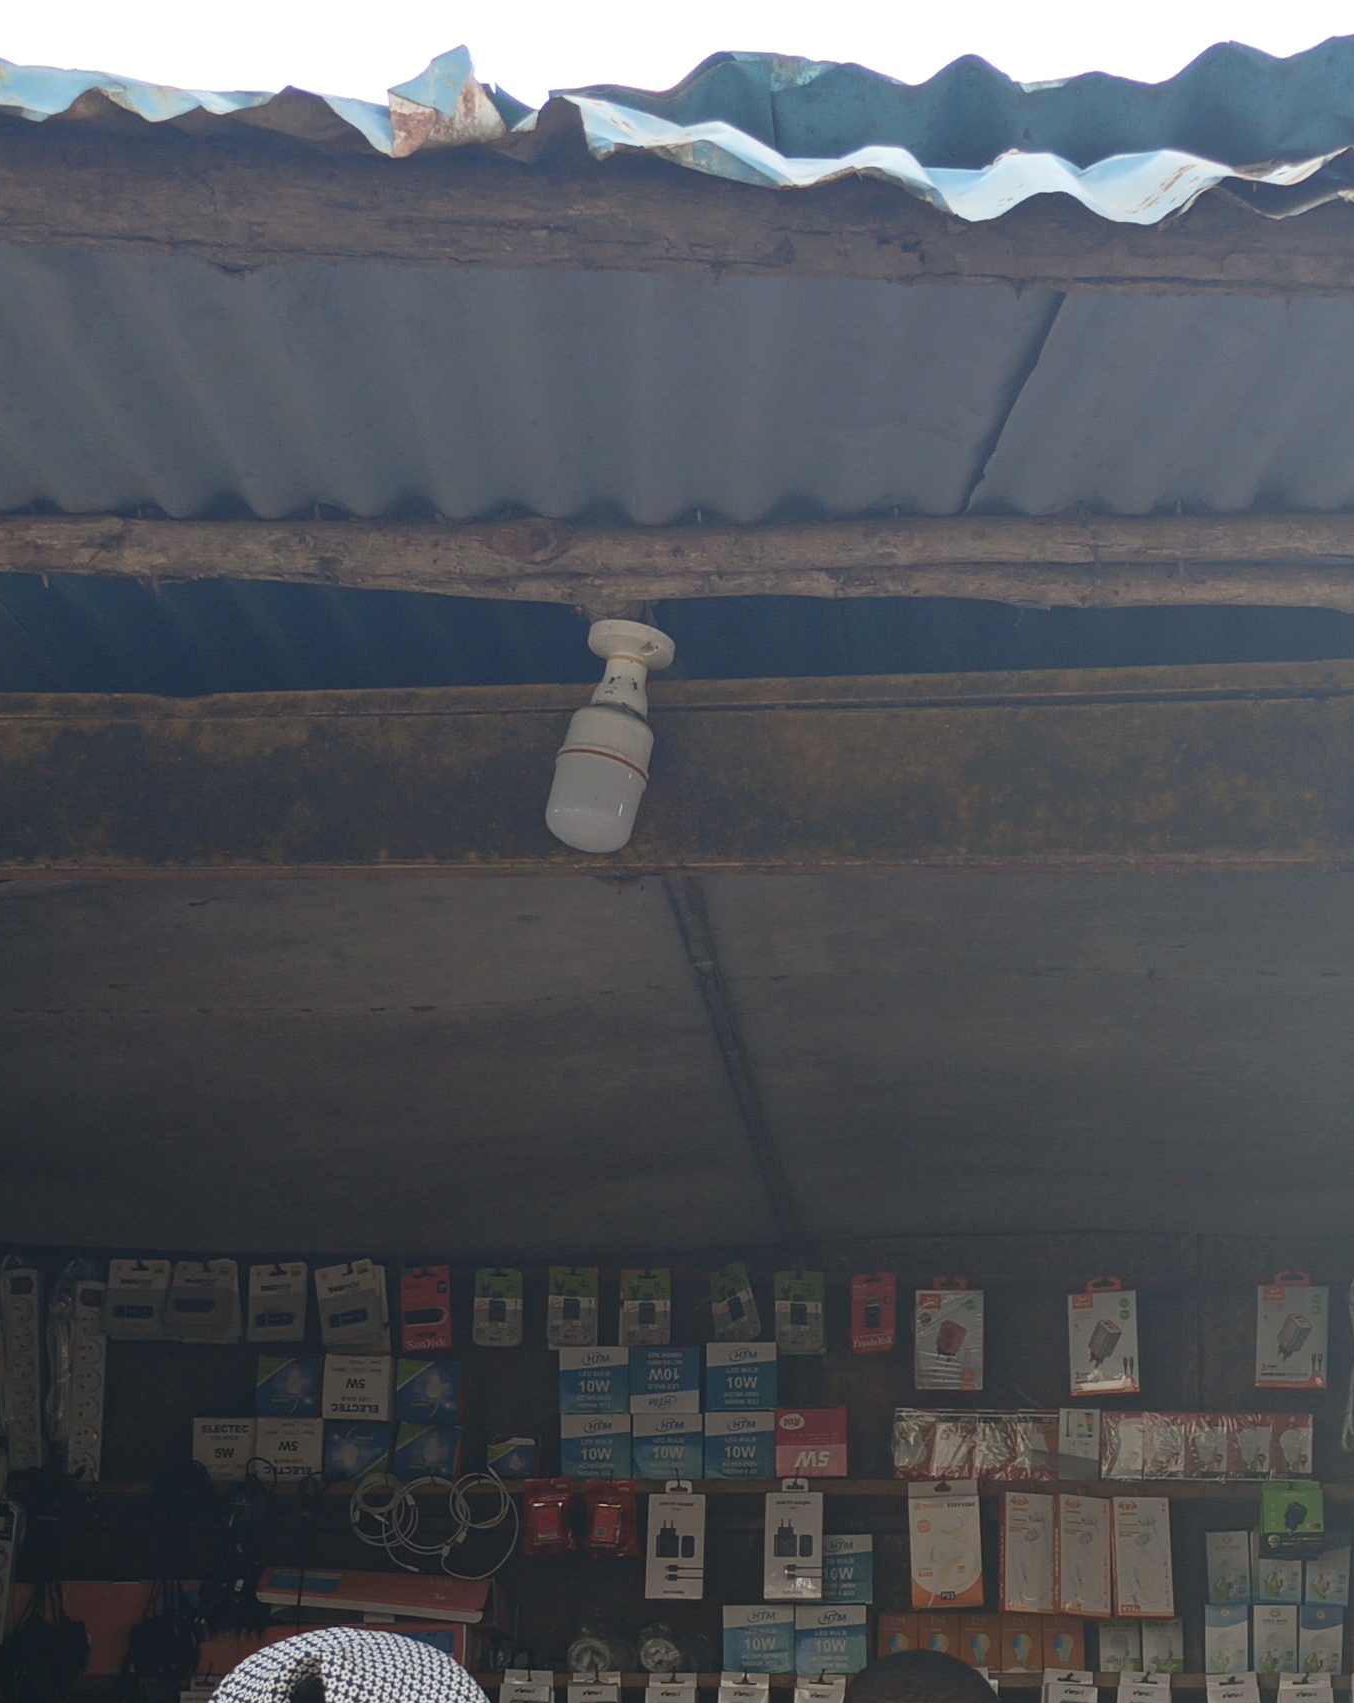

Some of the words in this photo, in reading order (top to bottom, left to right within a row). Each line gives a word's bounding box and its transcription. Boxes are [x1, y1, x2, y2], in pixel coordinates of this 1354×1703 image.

[648, 1369, 679, 1381] 10W
[345, 1378, 366, 1389] 5W
[578, 1380, 610, 1393] 10W
[726, 1376, 758, 1389] 10W
[278, 1440, 298, 1451] 5W
[215, 1447, 235, 1459] 5W
[580, 1448, 611, 1460] 10W
[652, 1446, 683, 1459] 10W
[724, 1446, 756, 1459] 10W
[794, 1451, 831, 1468] 5W
[823, 1567, 853, 1580] 10W
[744, 1638, 775, 1650] 10W
[815, 1640, 847, 1652] 10W
